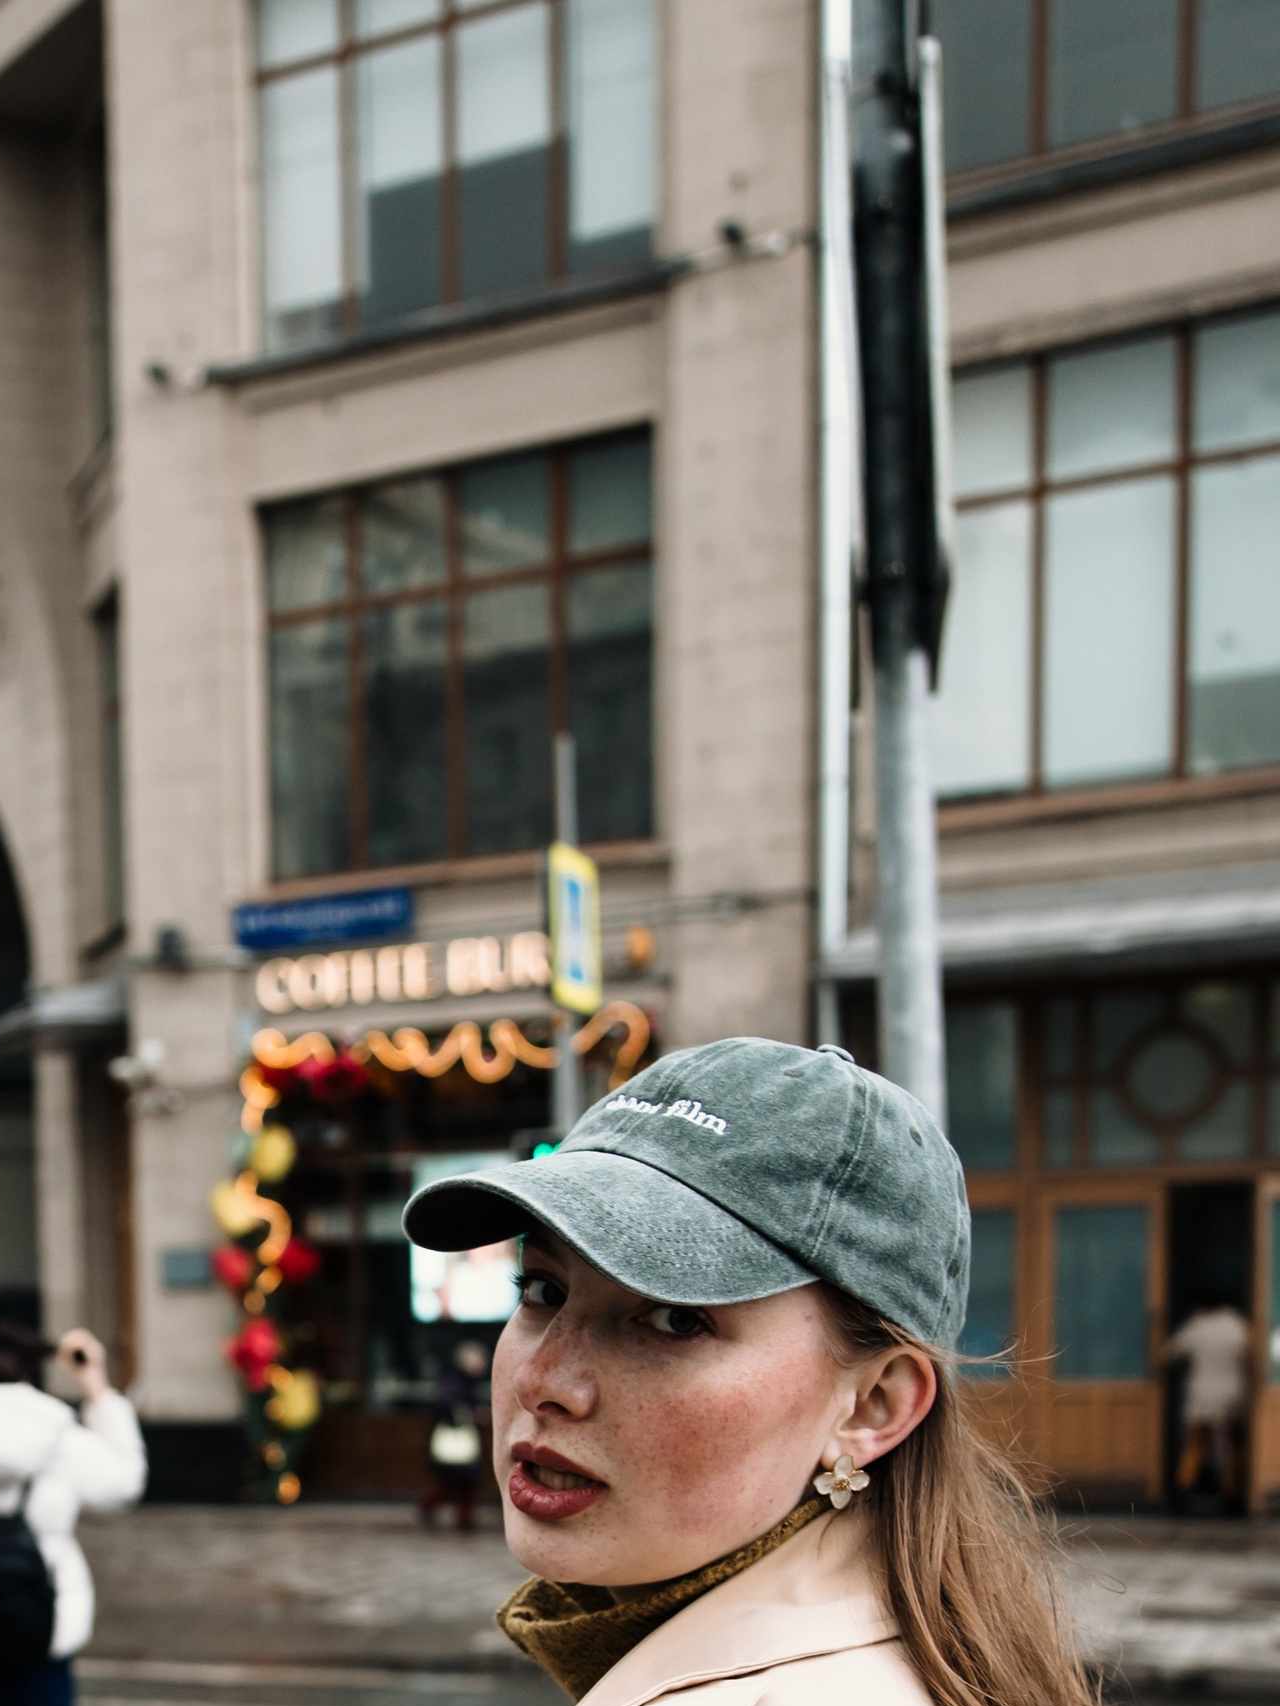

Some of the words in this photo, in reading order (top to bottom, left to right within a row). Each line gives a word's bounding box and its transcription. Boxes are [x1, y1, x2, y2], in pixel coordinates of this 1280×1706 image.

[257, 943, 440, 1013] COFFEE
[446, 931, 552, 996] BUR
[663, 1099, 728, 1135] film
